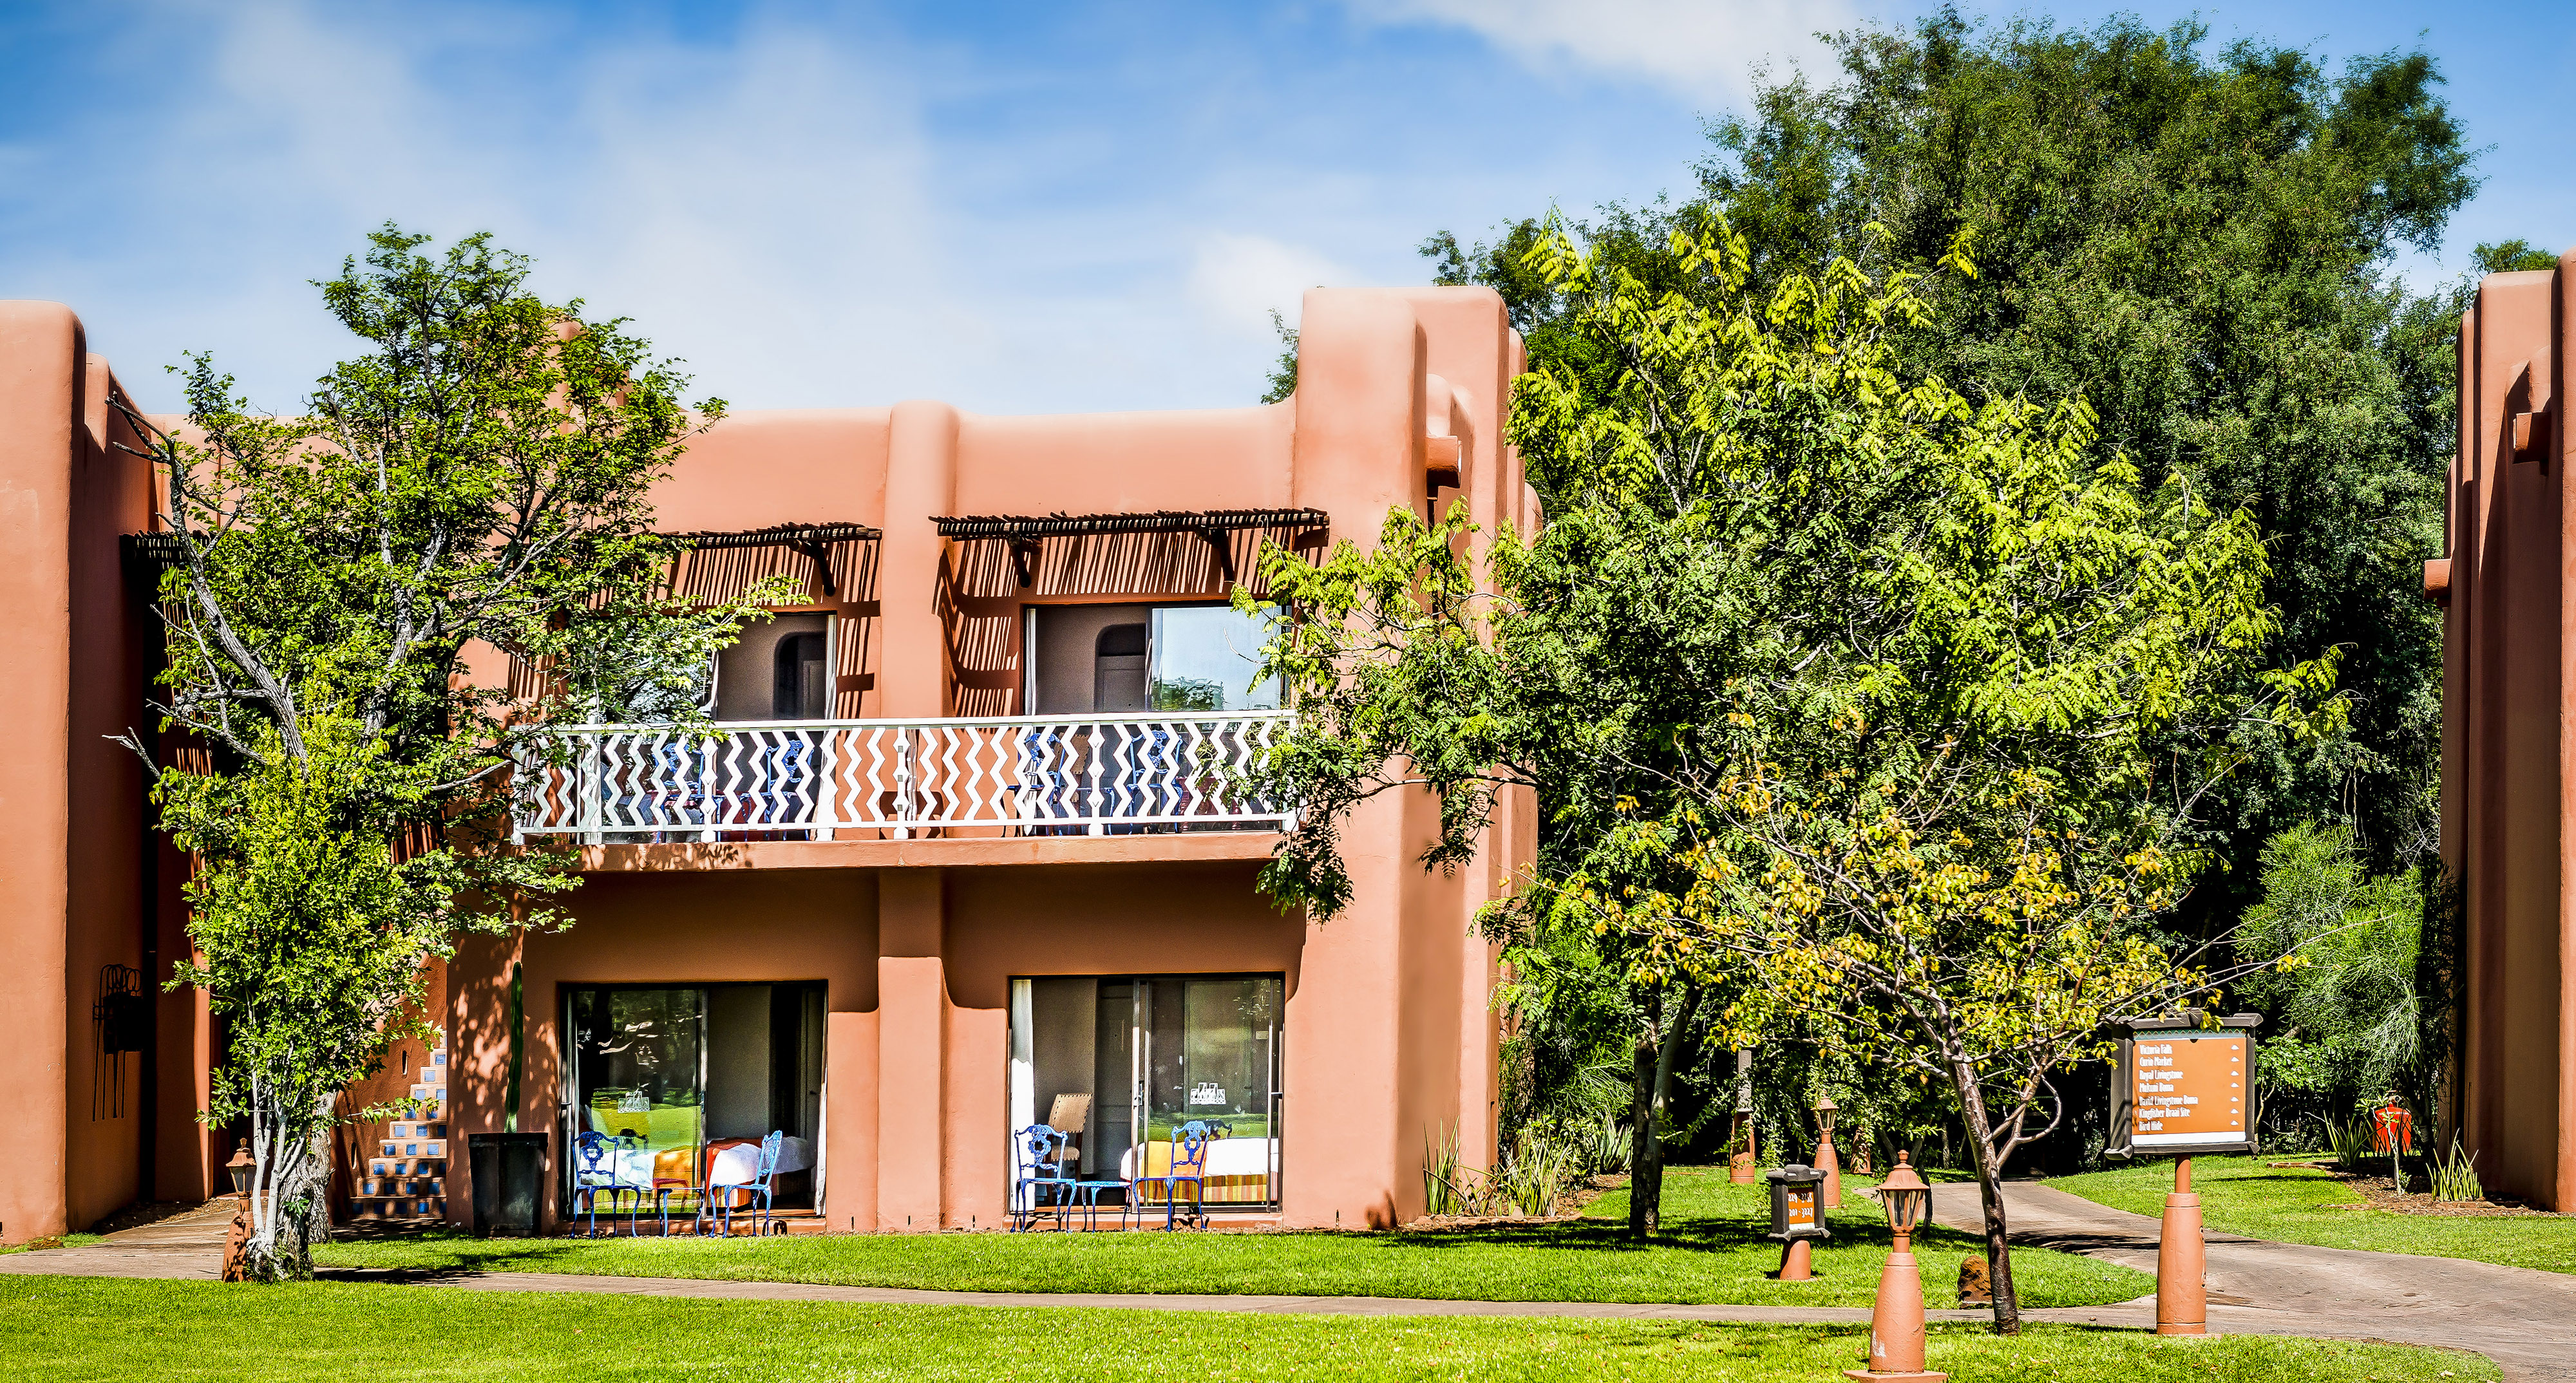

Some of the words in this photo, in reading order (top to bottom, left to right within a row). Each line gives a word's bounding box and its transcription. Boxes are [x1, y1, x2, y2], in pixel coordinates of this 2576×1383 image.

[2139, 1044, 2160, 1055] Victoria
[2139, 1057, 2154, 1066] Curio
[2154, 1056, 2174, 1066] Market
[2139, 1069, 2154, 1082] Royal
[2154, 1069, 2184, 1081] Livingstone
[2159, 1082, 2174, 1092] Boma
[2139, 1096, 2154, 1105] David
[2154, 1096, 2183, 1107] Livingstone
[2183, 1095, 2199, 1104] Boma
[2139, 1108, 2165, 1120] Kingfisher
[2165, 1107, 2180, 1118] Braai
[2180, 1107, 2190, 1117] Site
[2139, 1121, 2151, 1131] Bird
[2151, 1121, 2163, 1131] Hide
